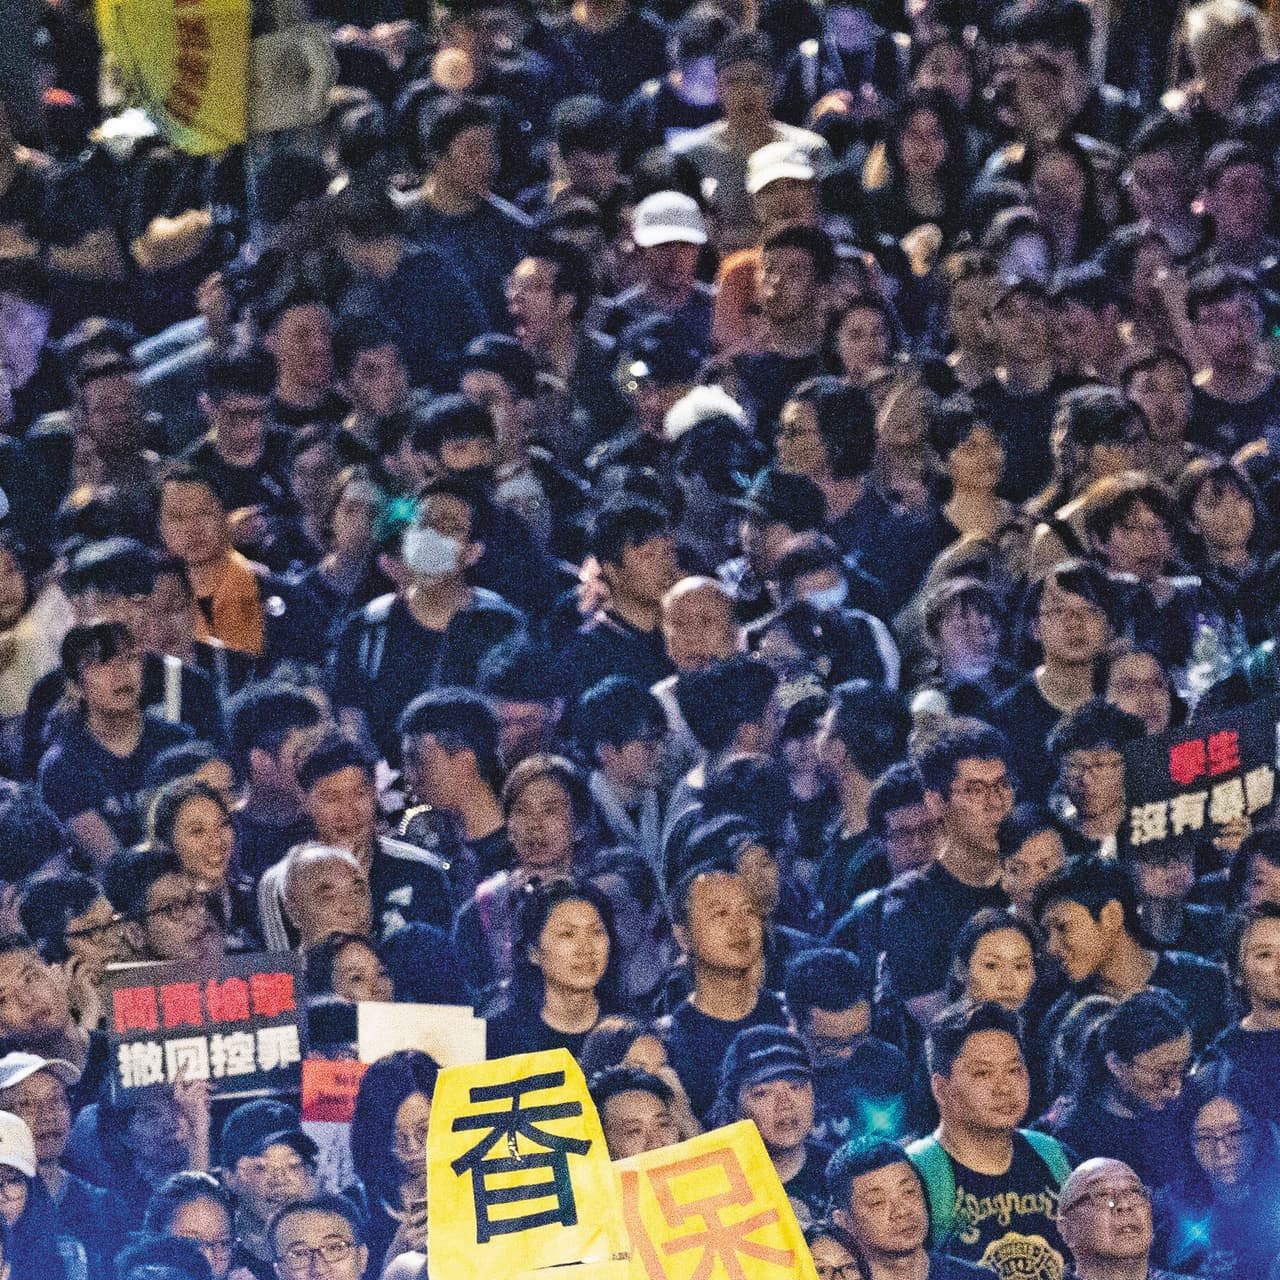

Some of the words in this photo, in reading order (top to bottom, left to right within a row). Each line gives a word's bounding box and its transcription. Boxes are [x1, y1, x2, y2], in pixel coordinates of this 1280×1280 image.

[1170, 730, 1240, 784] 學生
[1131, 763, 1275, 846] 沒有暴動
[114, 972, 296, 1033] 問責槍擊
[118, 1025, 301, 1088] 撤回控罪
